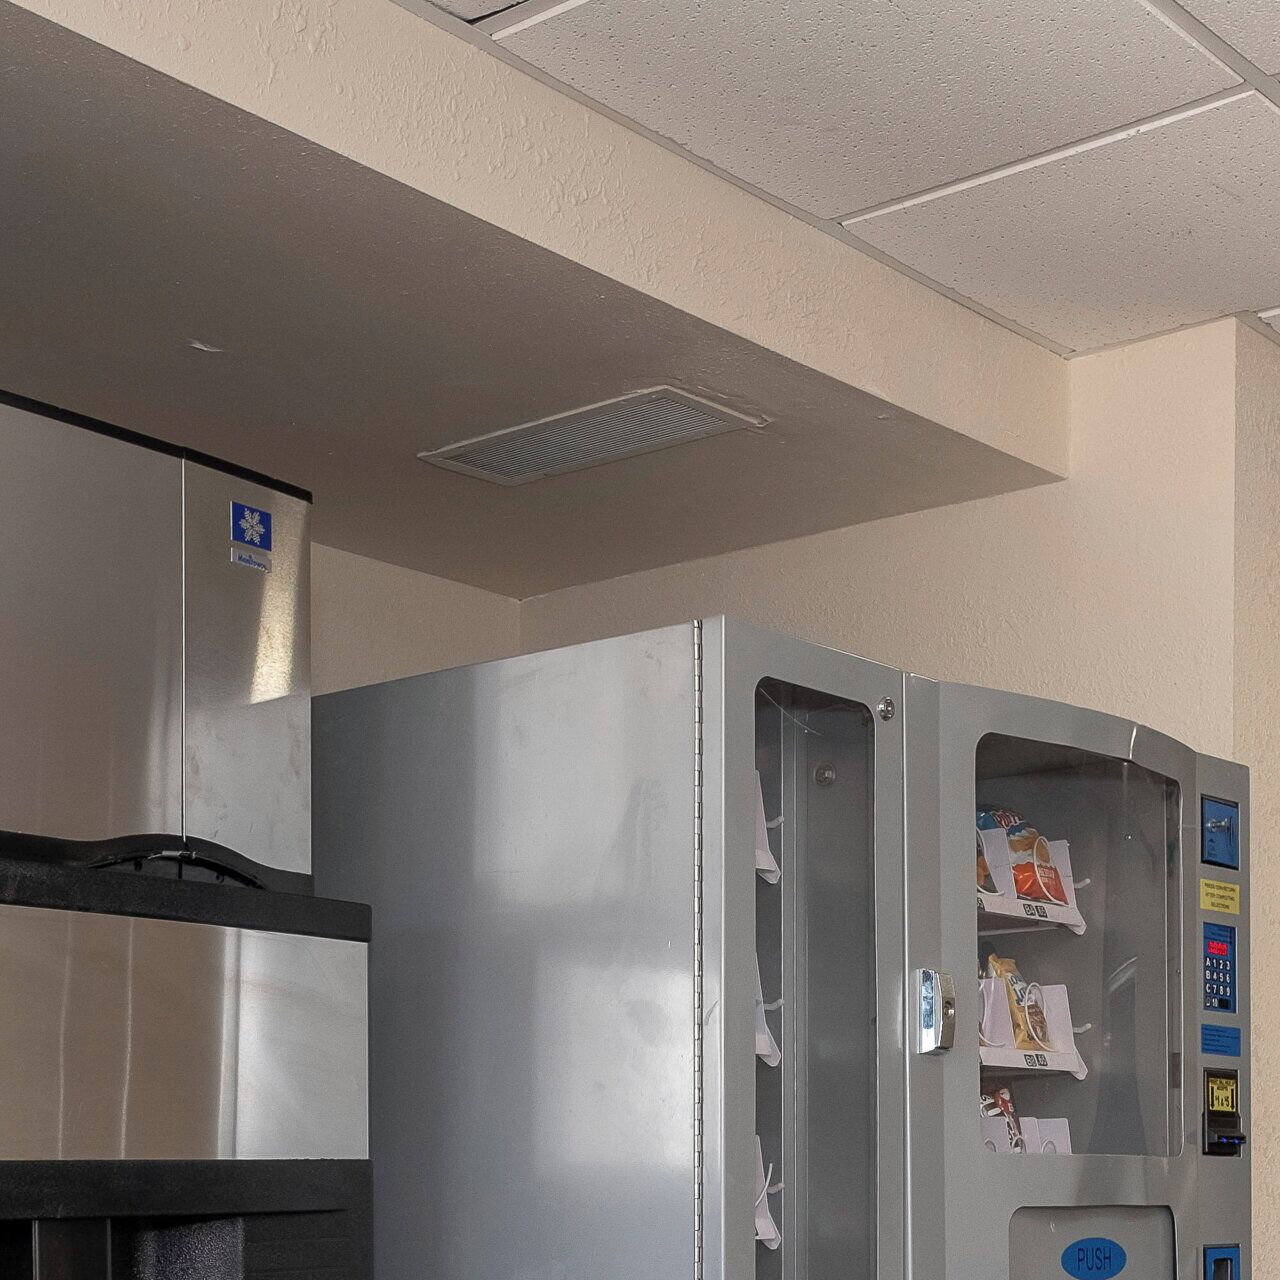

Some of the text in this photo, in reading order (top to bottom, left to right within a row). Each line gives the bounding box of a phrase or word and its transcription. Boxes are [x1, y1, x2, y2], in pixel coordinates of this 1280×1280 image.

[1205, 958, 1231, 970] A 1 2 3
[1205, 970, 1231, 983] B 4 5 6
[1205, 984, 1211, 993] C
[1213, 985, 1217, 994] 7
[1219, 986, 1224, 995] 8
[1077, 1247, 1111, 1271] PUSH
